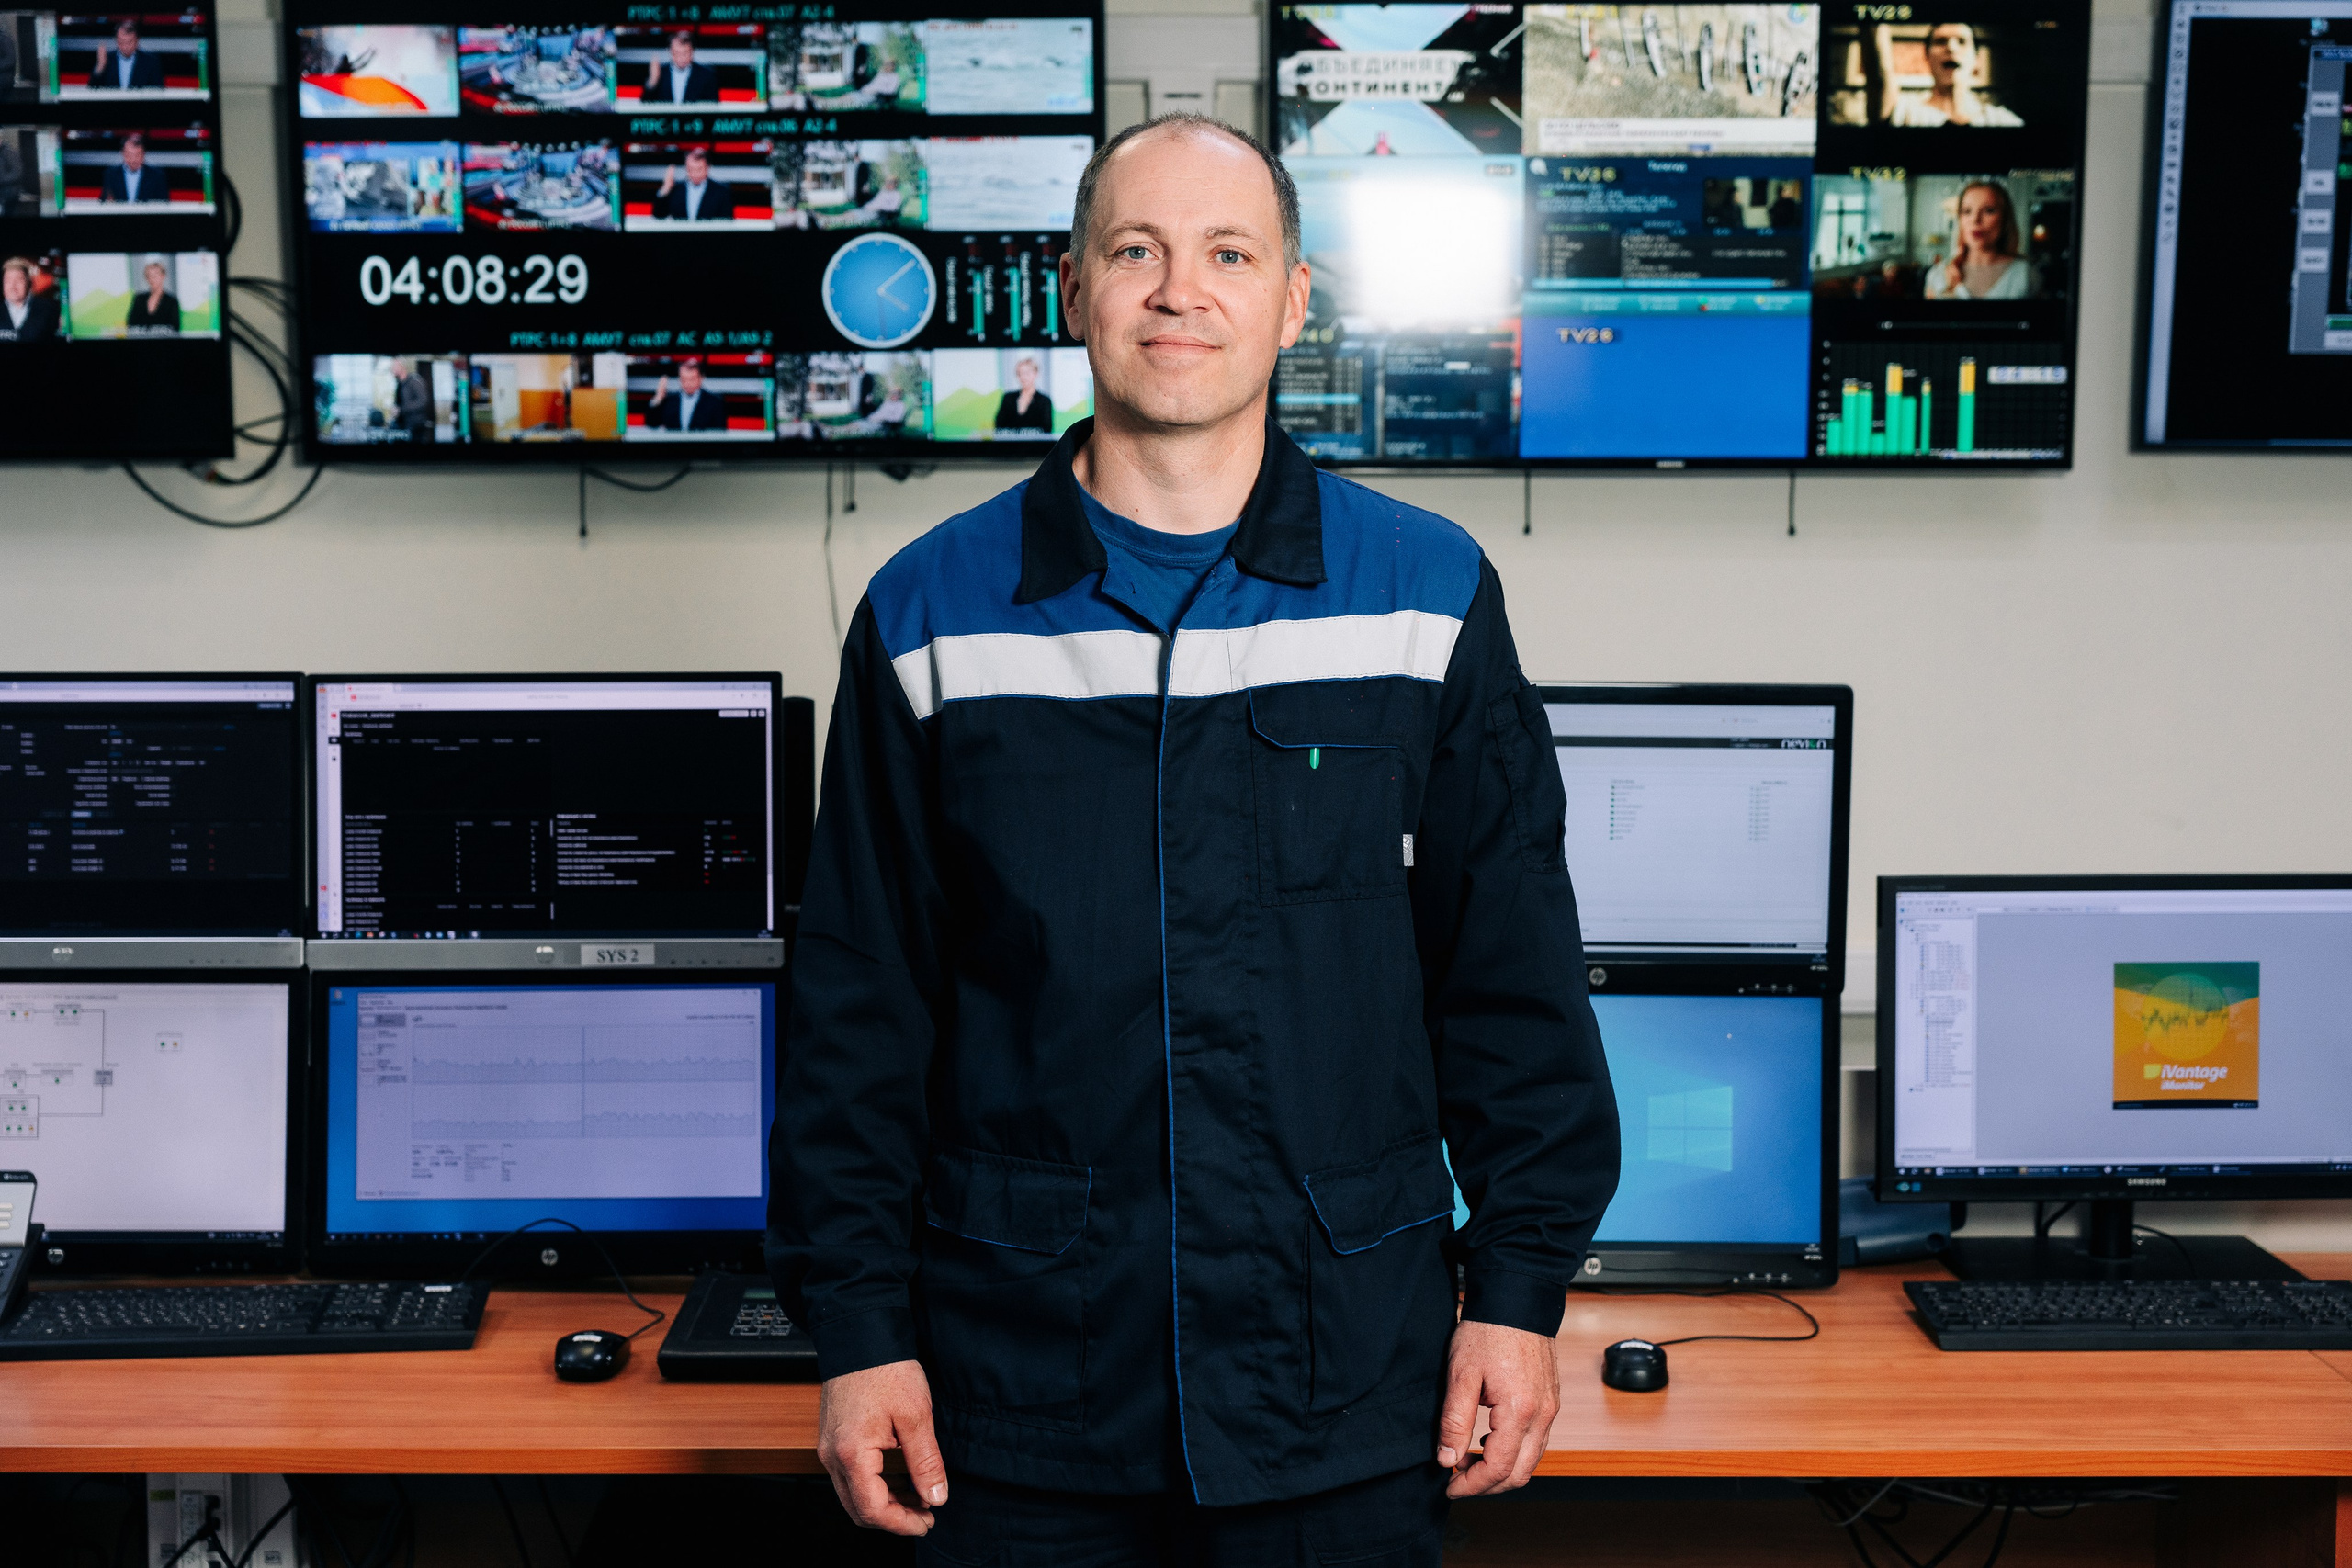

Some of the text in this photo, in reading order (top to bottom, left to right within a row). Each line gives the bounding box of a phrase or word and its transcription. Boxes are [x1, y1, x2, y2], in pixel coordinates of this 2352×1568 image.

[1309, 80, 1443, 95] ОНТИНЕНТ
[359, 254, 589, 306] 04:08:29
[596, 948, 639, 964] SYS 2
[2161, 1064, 2229, 1083] iVantage
